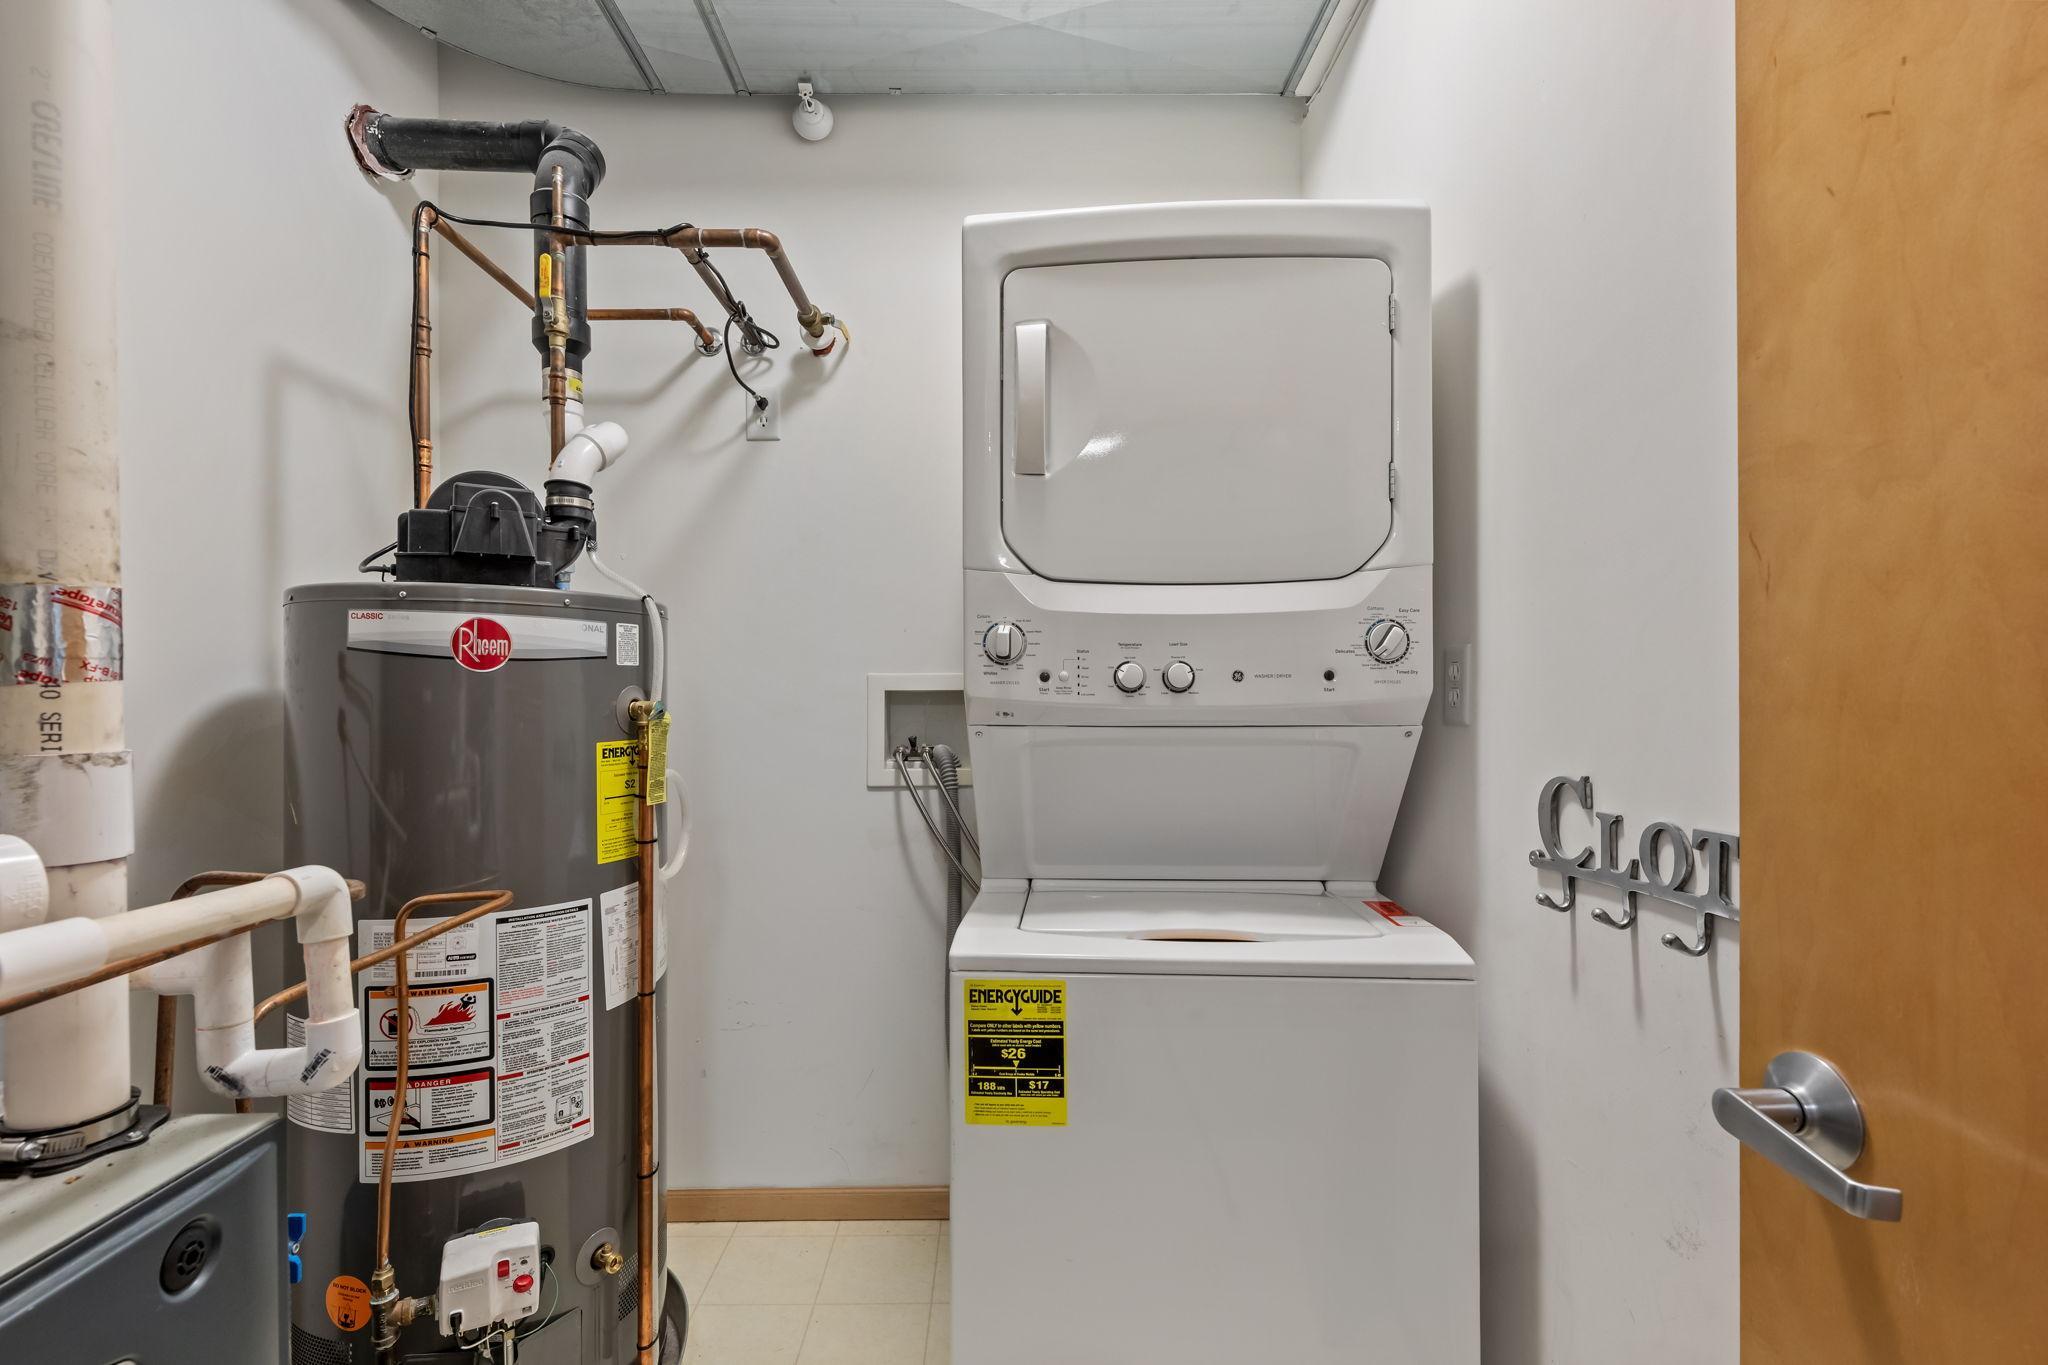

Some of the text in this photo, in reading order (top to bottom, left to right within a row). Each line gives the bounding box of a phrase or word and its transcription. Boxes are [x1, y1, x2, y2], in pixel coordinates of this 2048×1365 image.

[33, 351, 57, 441] CELLULAR
[34, 450, 58, 496] CORE
[350, 612, 384, 620] CLASSIC
[456, 619, 511, 663] Rheem
[508, 914, 536, 922] INSTALLATION
[410, 988, 455, 997] WARNING
[969, 988, 1062, 1005] ENERGYGUIDE
[1001, 1047, 1026, 1059] $26
[414, 1079, 451, 1088] DANGER
[977, 1081, 996, 1090] 188
[1029, 1080, 1050, 1090] $17
[414, 1137, 455, 1147] WARNING
[349, 1286, 367, 1294] BLOCK
